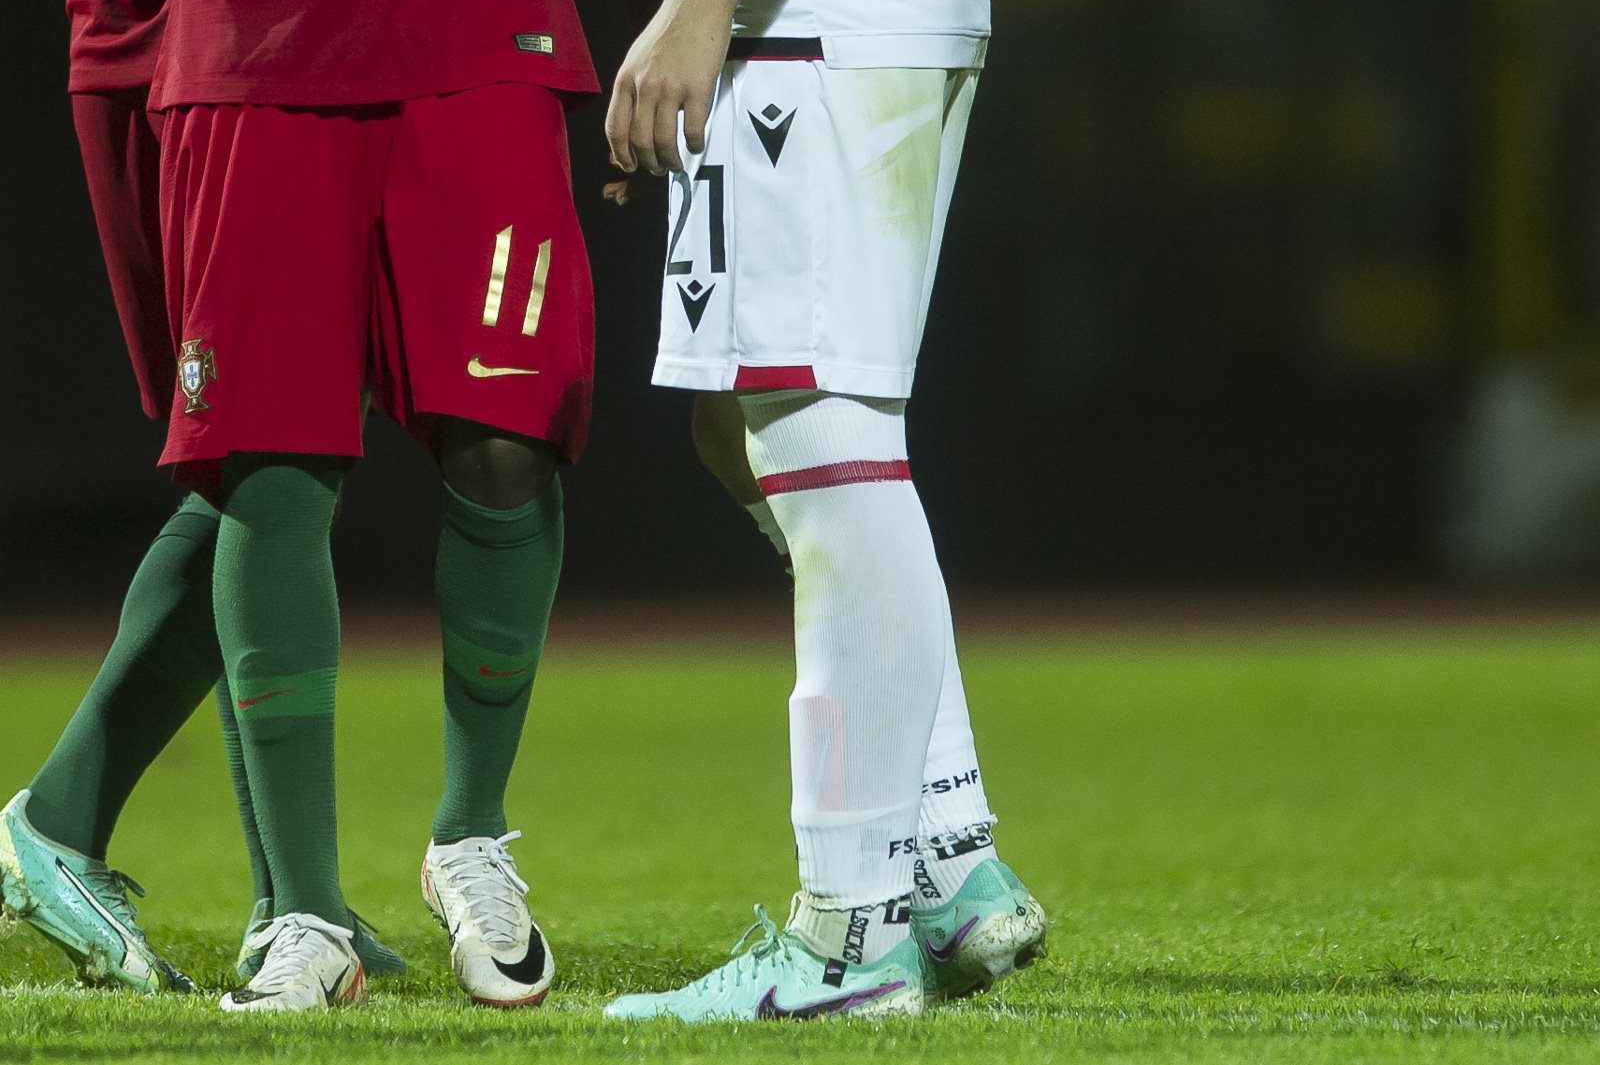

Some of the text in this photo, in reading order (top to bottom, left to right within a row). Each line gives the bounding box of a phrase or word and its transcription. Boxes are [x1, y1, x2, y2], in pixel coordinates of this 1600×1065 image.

[666, 165, 727, 276] 21
[482, 224, 552, 336] 11
[888, 836, 917, 859] FS
